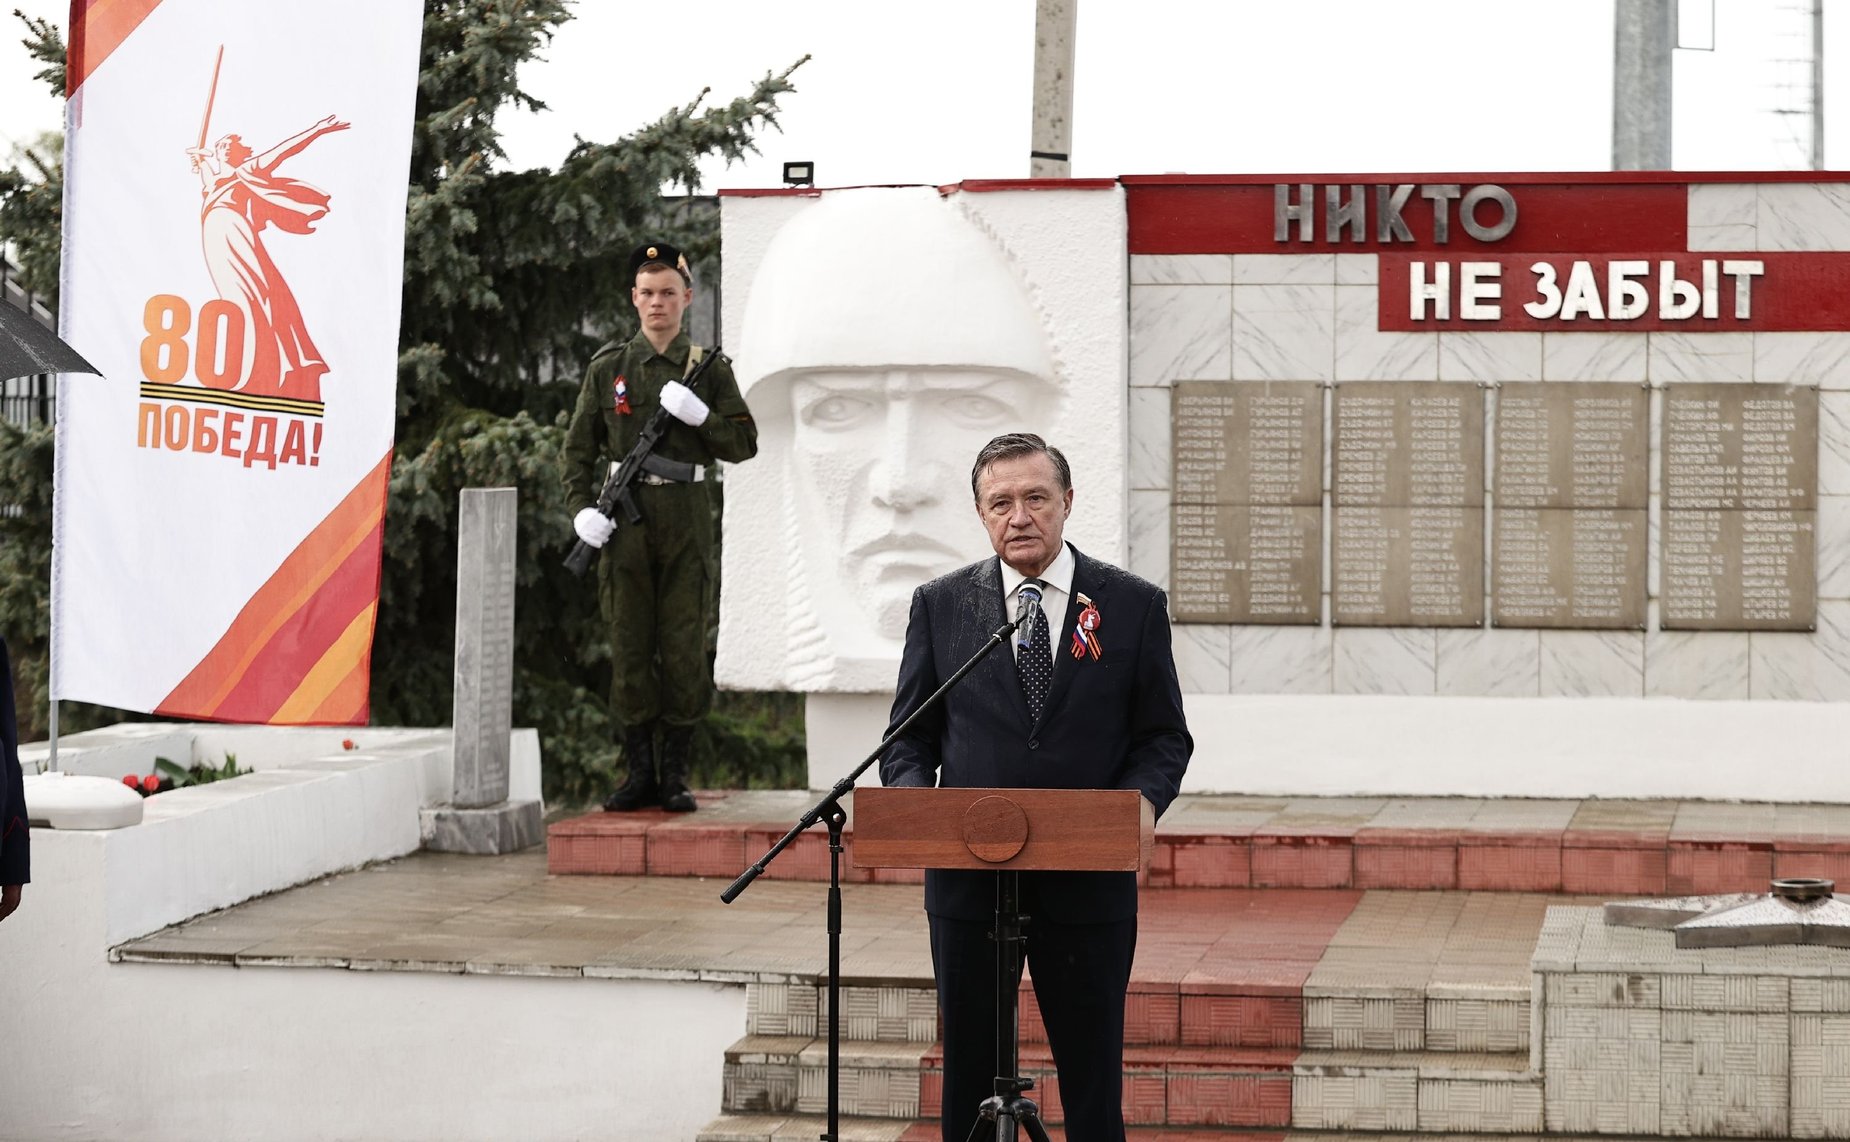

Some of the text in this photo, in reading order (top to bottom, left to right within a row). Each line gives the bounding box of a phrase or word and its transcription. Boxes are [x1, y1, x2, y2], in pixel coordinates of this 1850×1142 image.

[1274, 184, 1518, 243] НИКТО
[1410, 260, 1765, 321] НЕ ЗАБЫТ
[140, 294, 246, 390] 80
[138, 403, 323, 470] ПОБЕДА!
